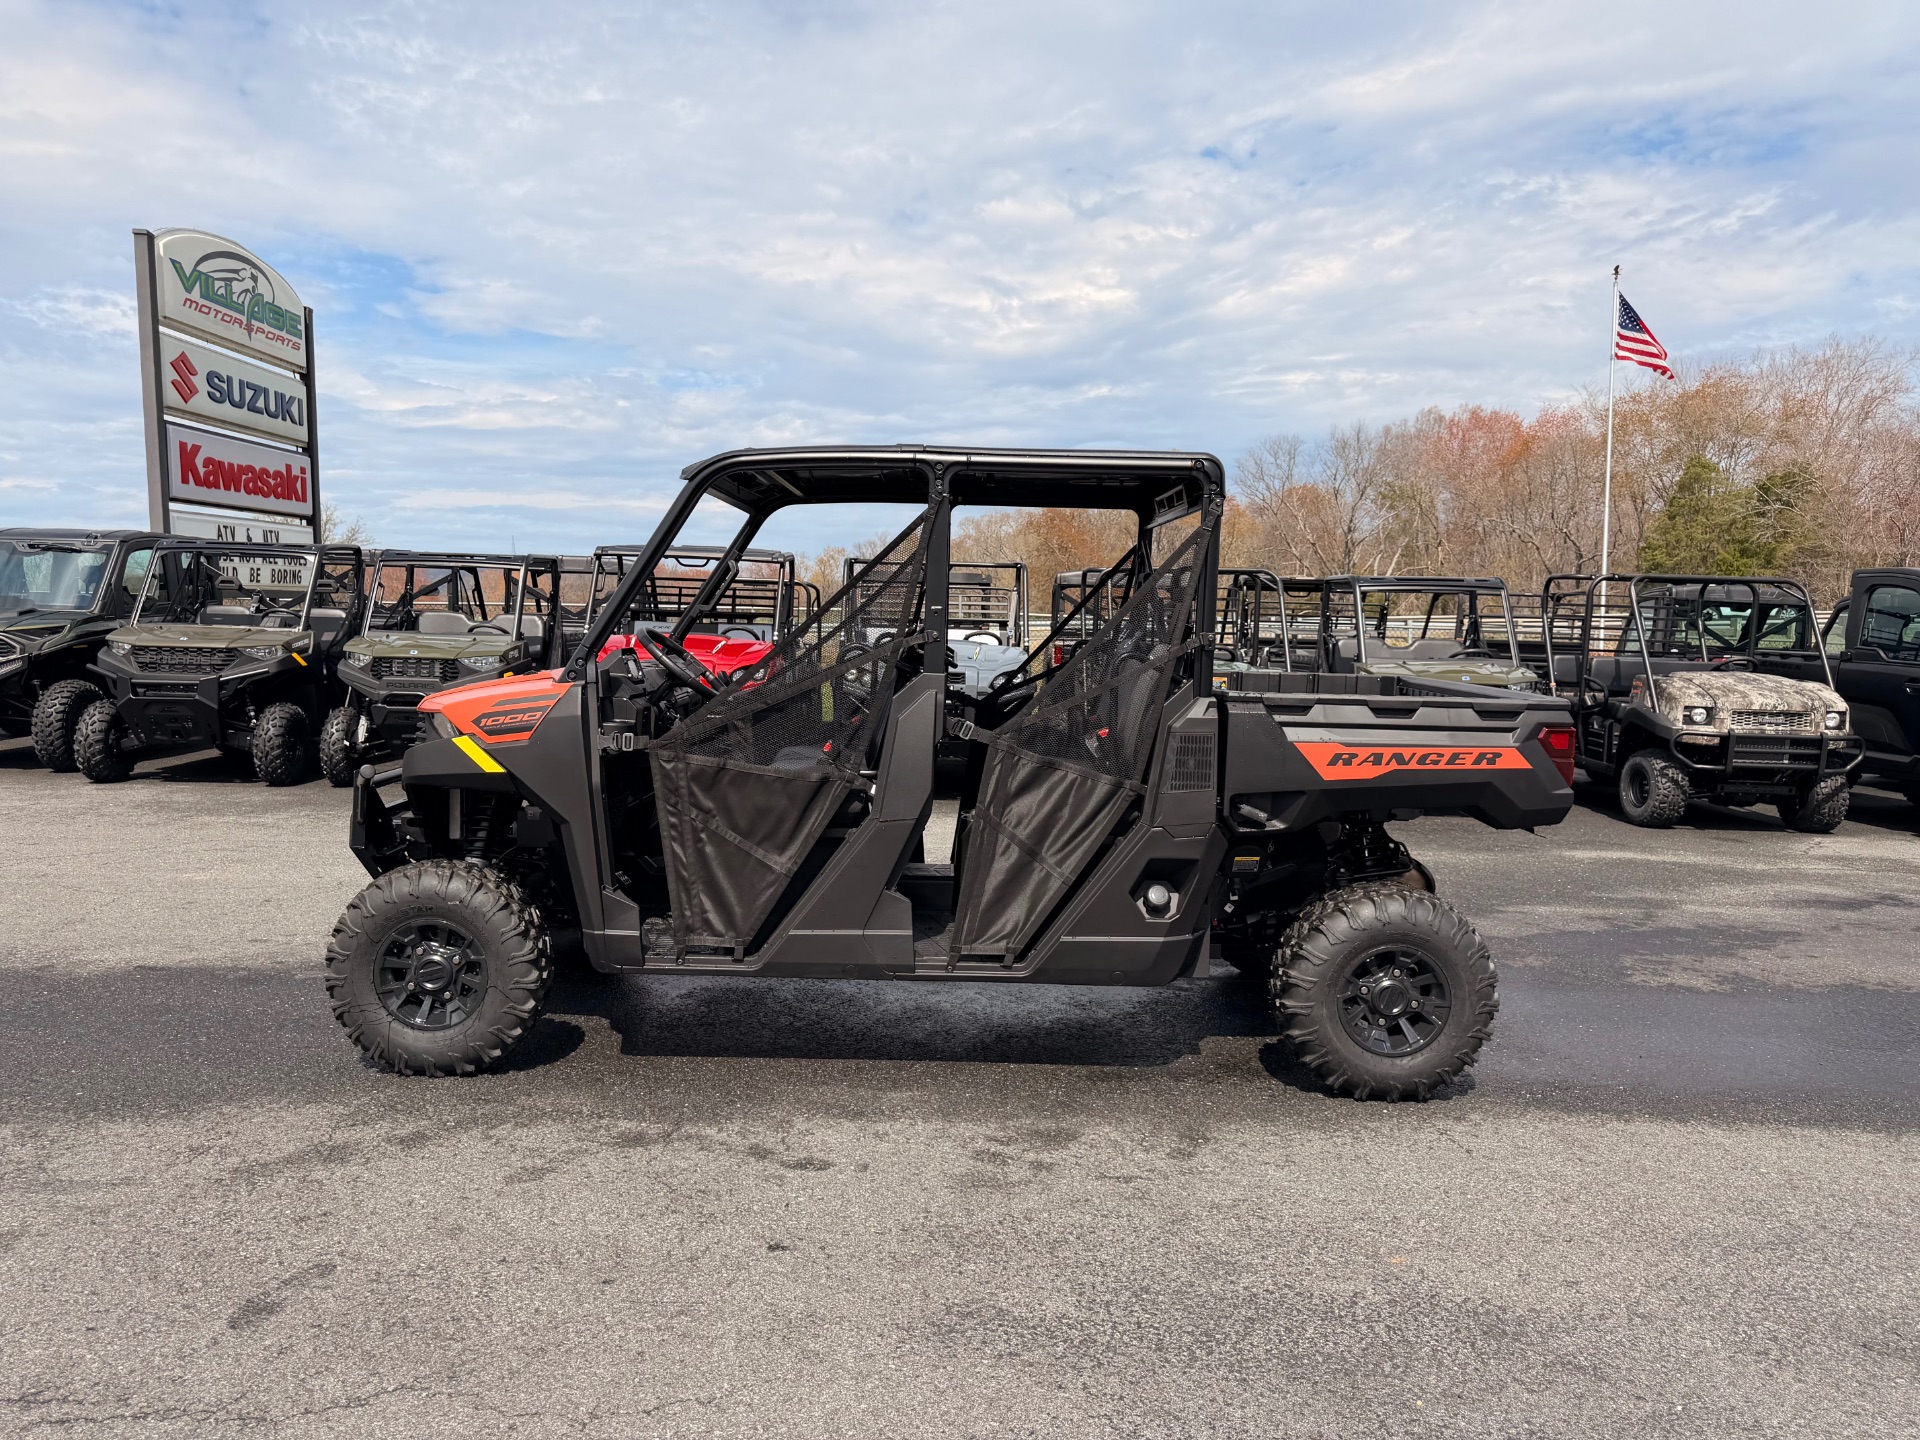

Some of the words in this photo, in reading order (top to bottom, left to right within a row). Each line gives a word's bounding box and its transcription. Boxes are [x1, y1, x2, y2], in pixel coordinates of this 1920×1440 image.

[169, 257, 302, 341] VILLAGE
[182, 297, 302, 351] MOTORSPORTS
[206, 369, 304, 427] SUZUKI
[178, 440, 308, 503] Kawasaki
[217, 524, 236, 542] ATV
[262, 529, 280, 543] UTV
[249, 567, 261, 584] BE
[271, 568, 302, 585] BORING
[386, 681, 435, 690] POLARIS
[479, 711, 543, 727] 1000
[1326, 751, 1503, 767] RANGER
